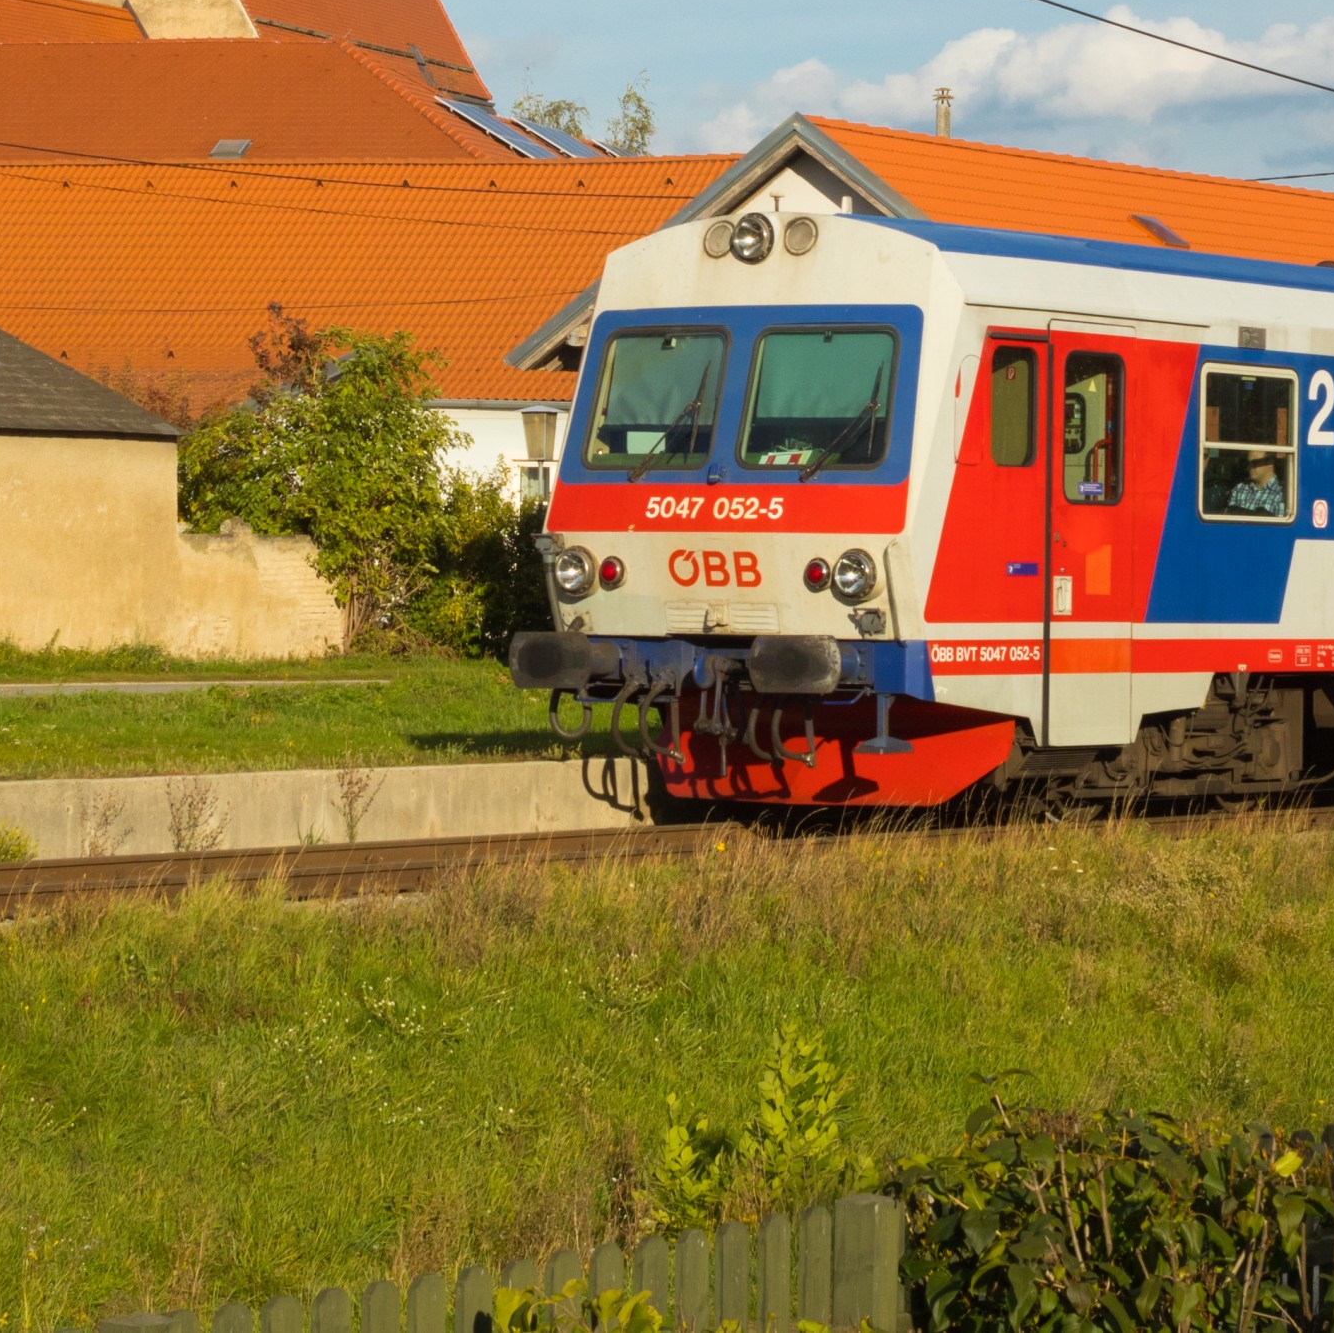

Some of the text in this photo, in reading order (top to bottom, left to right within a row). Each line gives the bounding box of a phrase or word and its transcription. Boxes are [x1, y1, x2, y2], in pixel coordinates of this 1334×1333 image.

[1307, 369, 1334, 445] 2
[645, 496, 784, 519] 5047 052-5
[668, 549, 762, 587] ÖBB
[931, 644, 1040, 662] ÖBB BVT 5047 052-5
